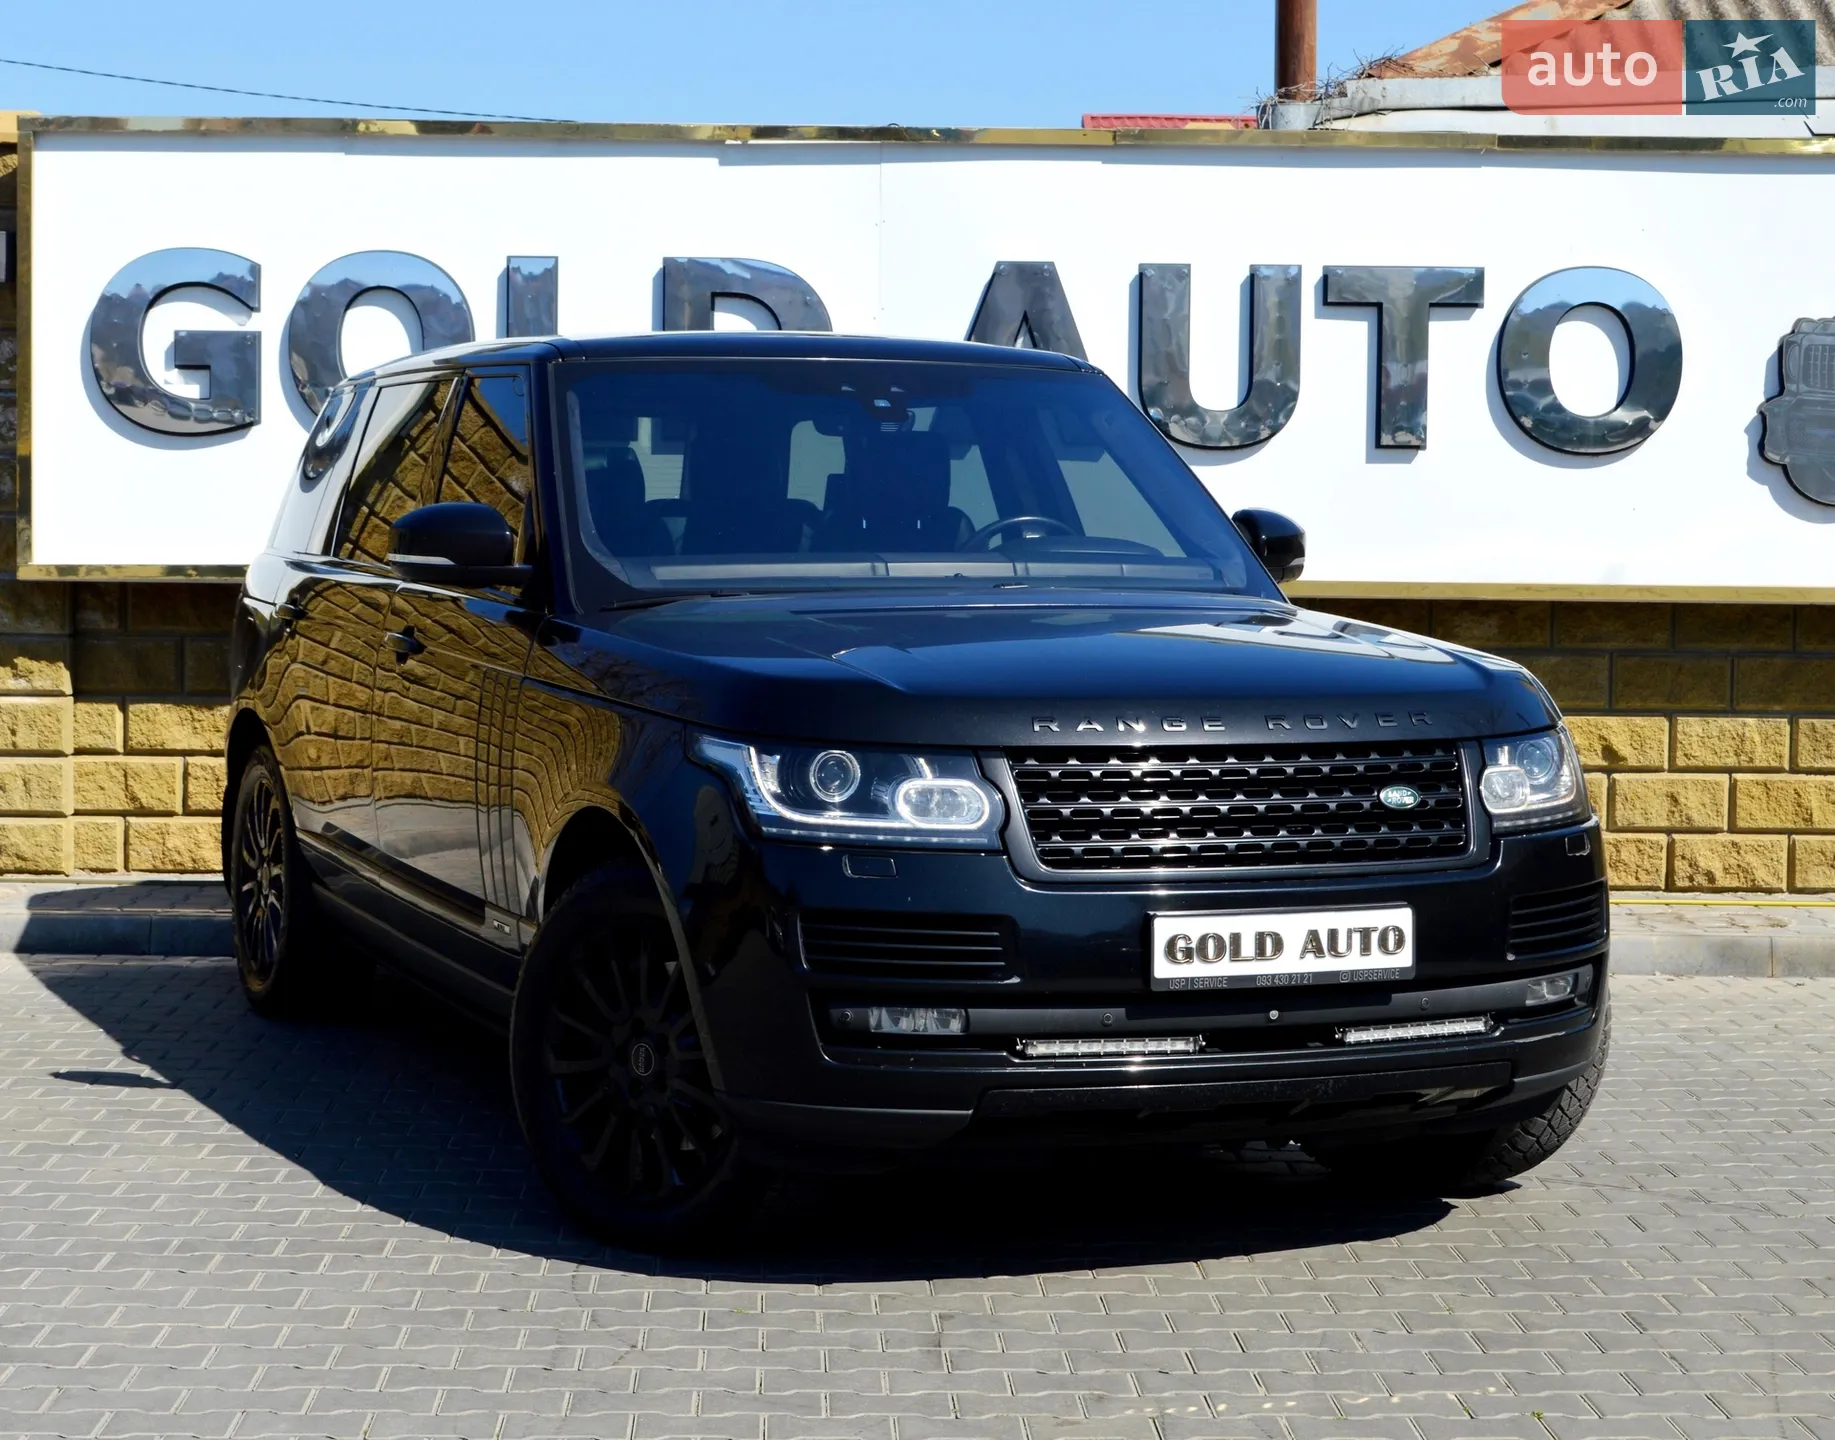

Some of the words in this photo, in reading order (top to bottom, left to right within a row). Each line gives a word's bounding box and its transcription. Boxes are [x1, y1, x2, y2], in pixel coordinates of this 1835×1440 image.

[1032, 716, 1225, 733] RANGE
[1266, 712, 1432, 731] ROVER
[1165, 931, 1284, 964] GOLD
[1300, 925, 1406, 958] AUTO
[1256, 976, 1272, 986] 093
[1274, 975, 1290, 985] 430
[1292, 974, 1301, 984] 21
[1303, 973, 1313, 984] 21
[1353, 969, 1400, 981] USPSERVICE
[1169, 979, 1185, 989] USP
[1193, 977, 1227, 988] SERVICE
